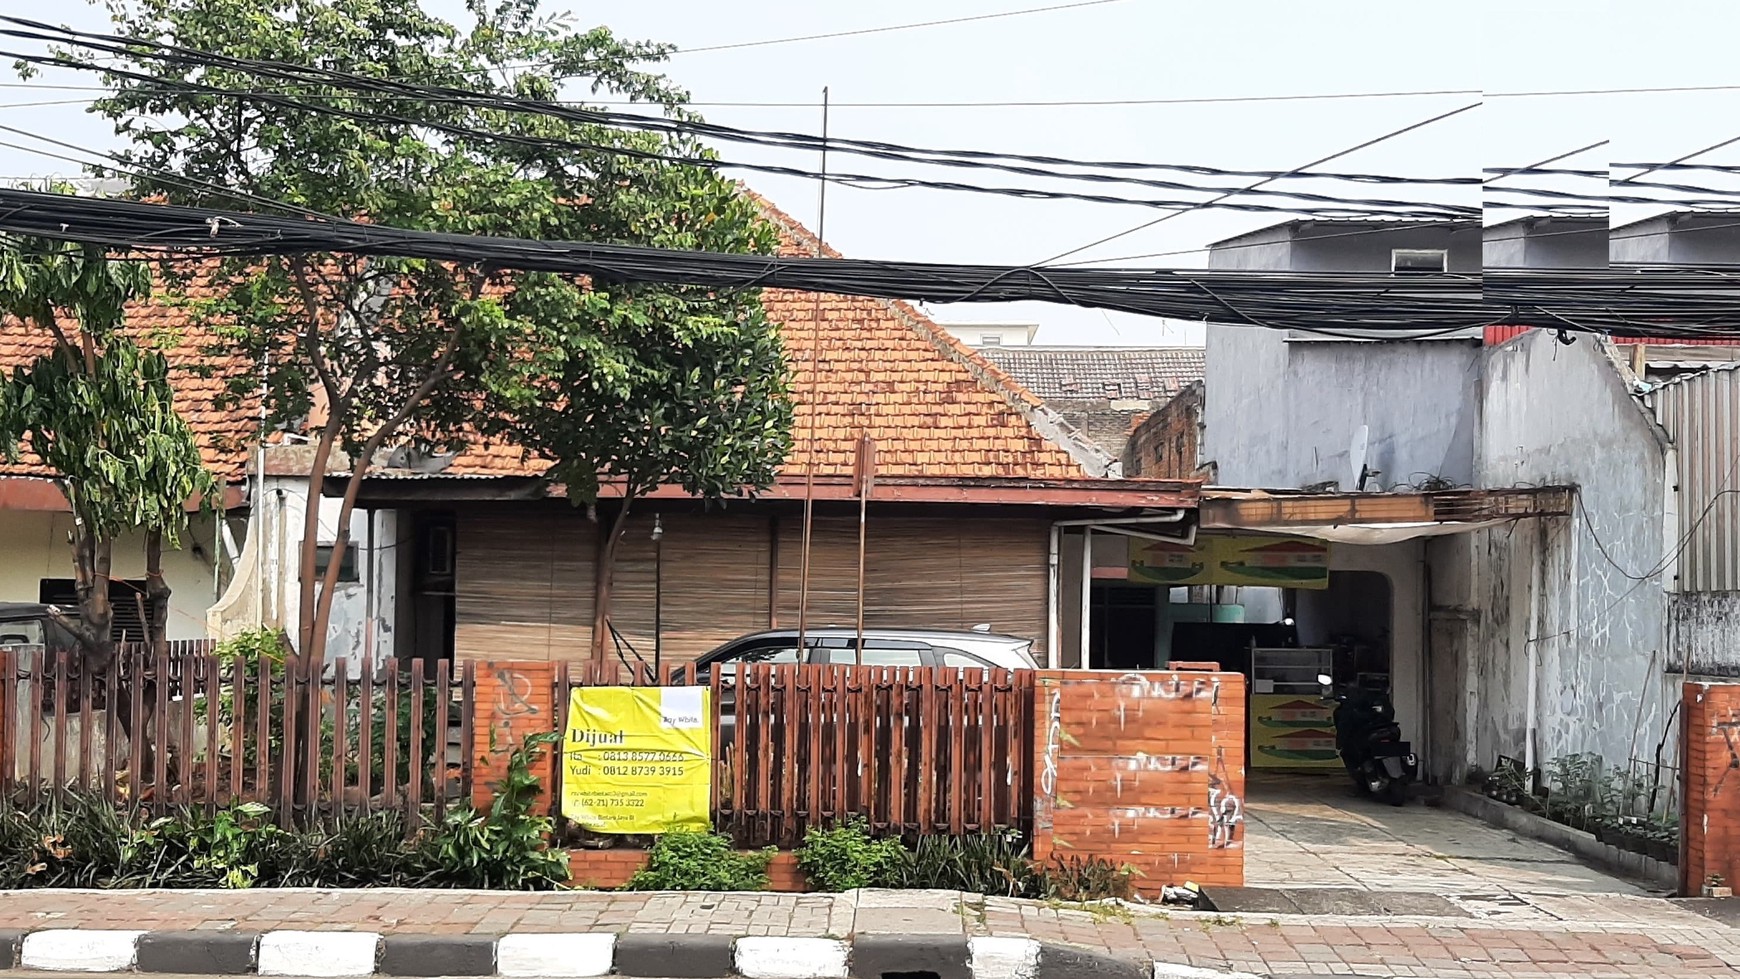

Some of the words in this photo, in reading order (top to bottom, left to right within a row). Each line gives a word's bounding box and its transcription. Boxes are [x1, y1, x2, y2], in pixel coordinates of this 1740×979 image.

[571, 728, 623, 747] Dijual
[603, 751, 629, 761] 0813
[631, 752, 656, 761] 8577
[570, 766, 591, 775] Yudi
[603, 766, 628, 775] 0812
[631, 766, 656, 775] 8739
[659, 766, 684, 775] 3915
